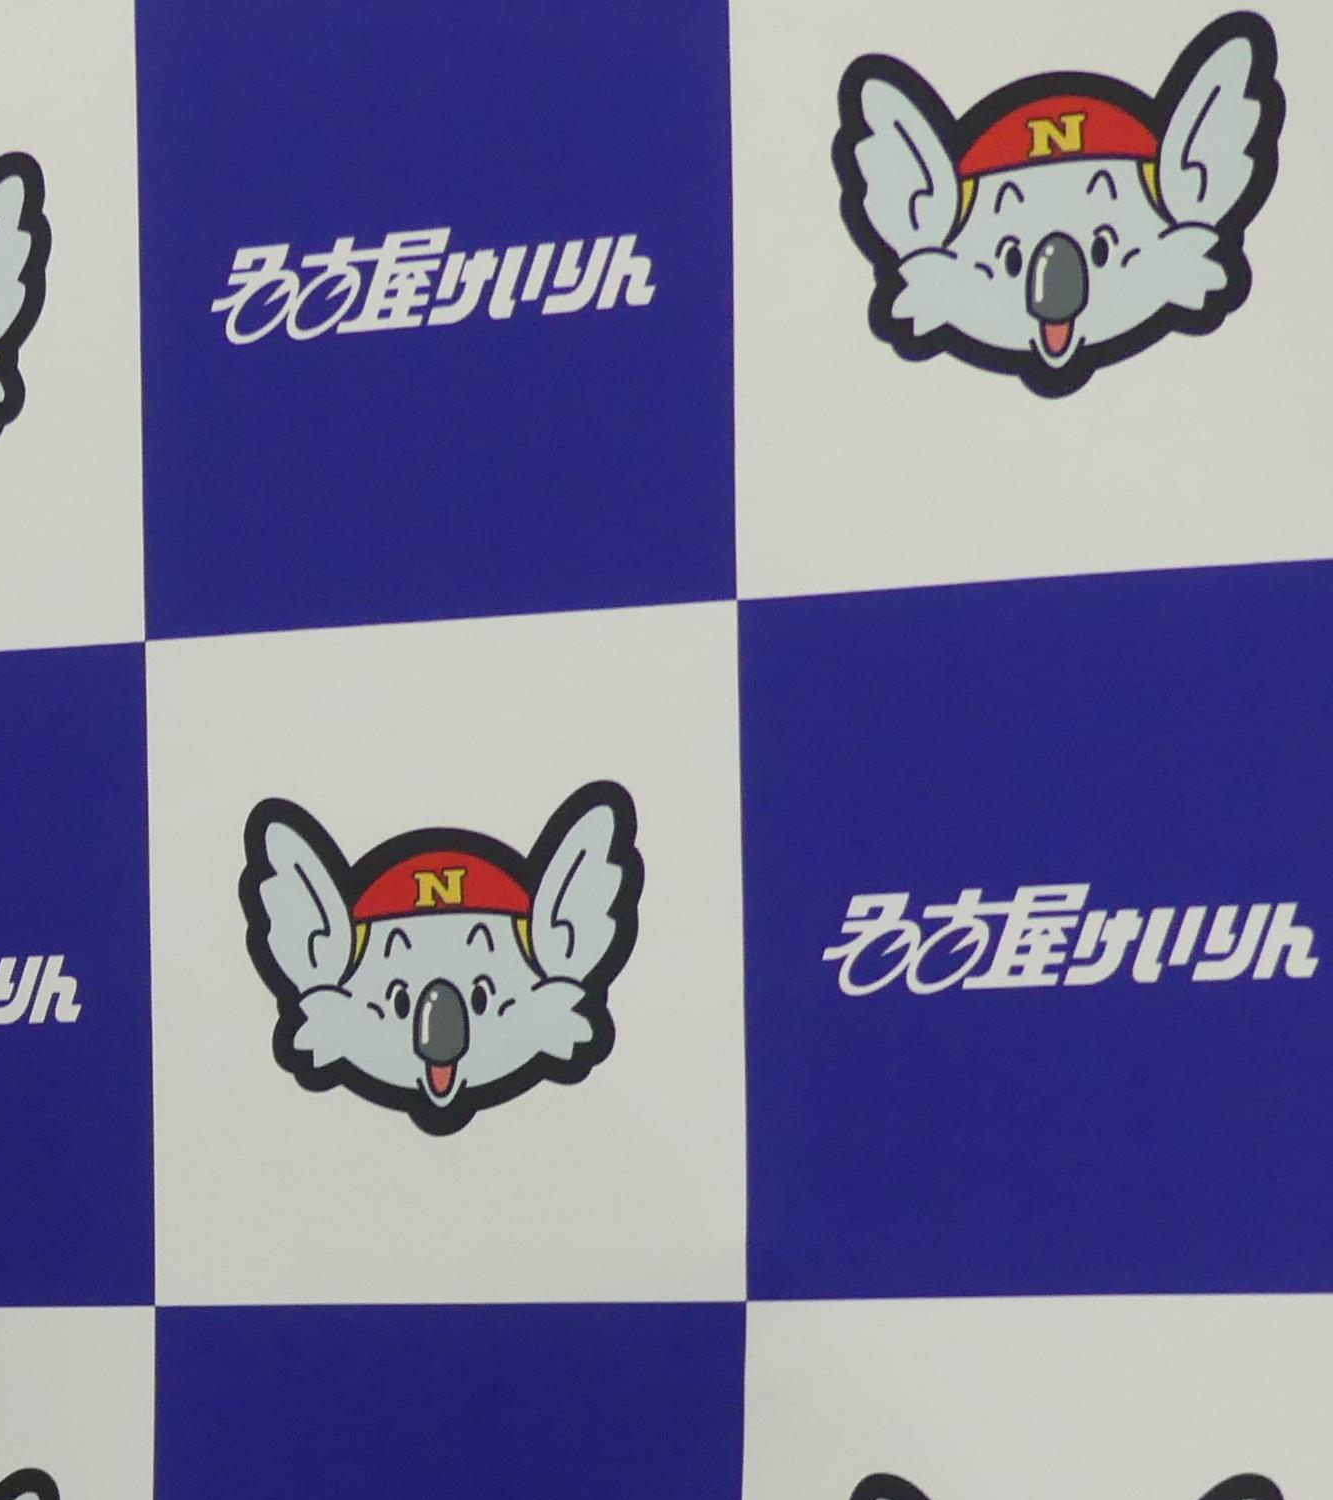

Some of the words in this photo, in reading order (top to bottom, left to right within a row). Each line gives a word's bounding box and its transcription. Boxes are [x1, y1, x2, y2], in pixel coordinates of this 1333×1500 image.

[1029, 114, 1085, 157] N
[213, 227, 656, 344] 名古屋けいりん
[415, 869, 466, 907] N
[822, 883, 1317, 996] 名古屋けいりん
